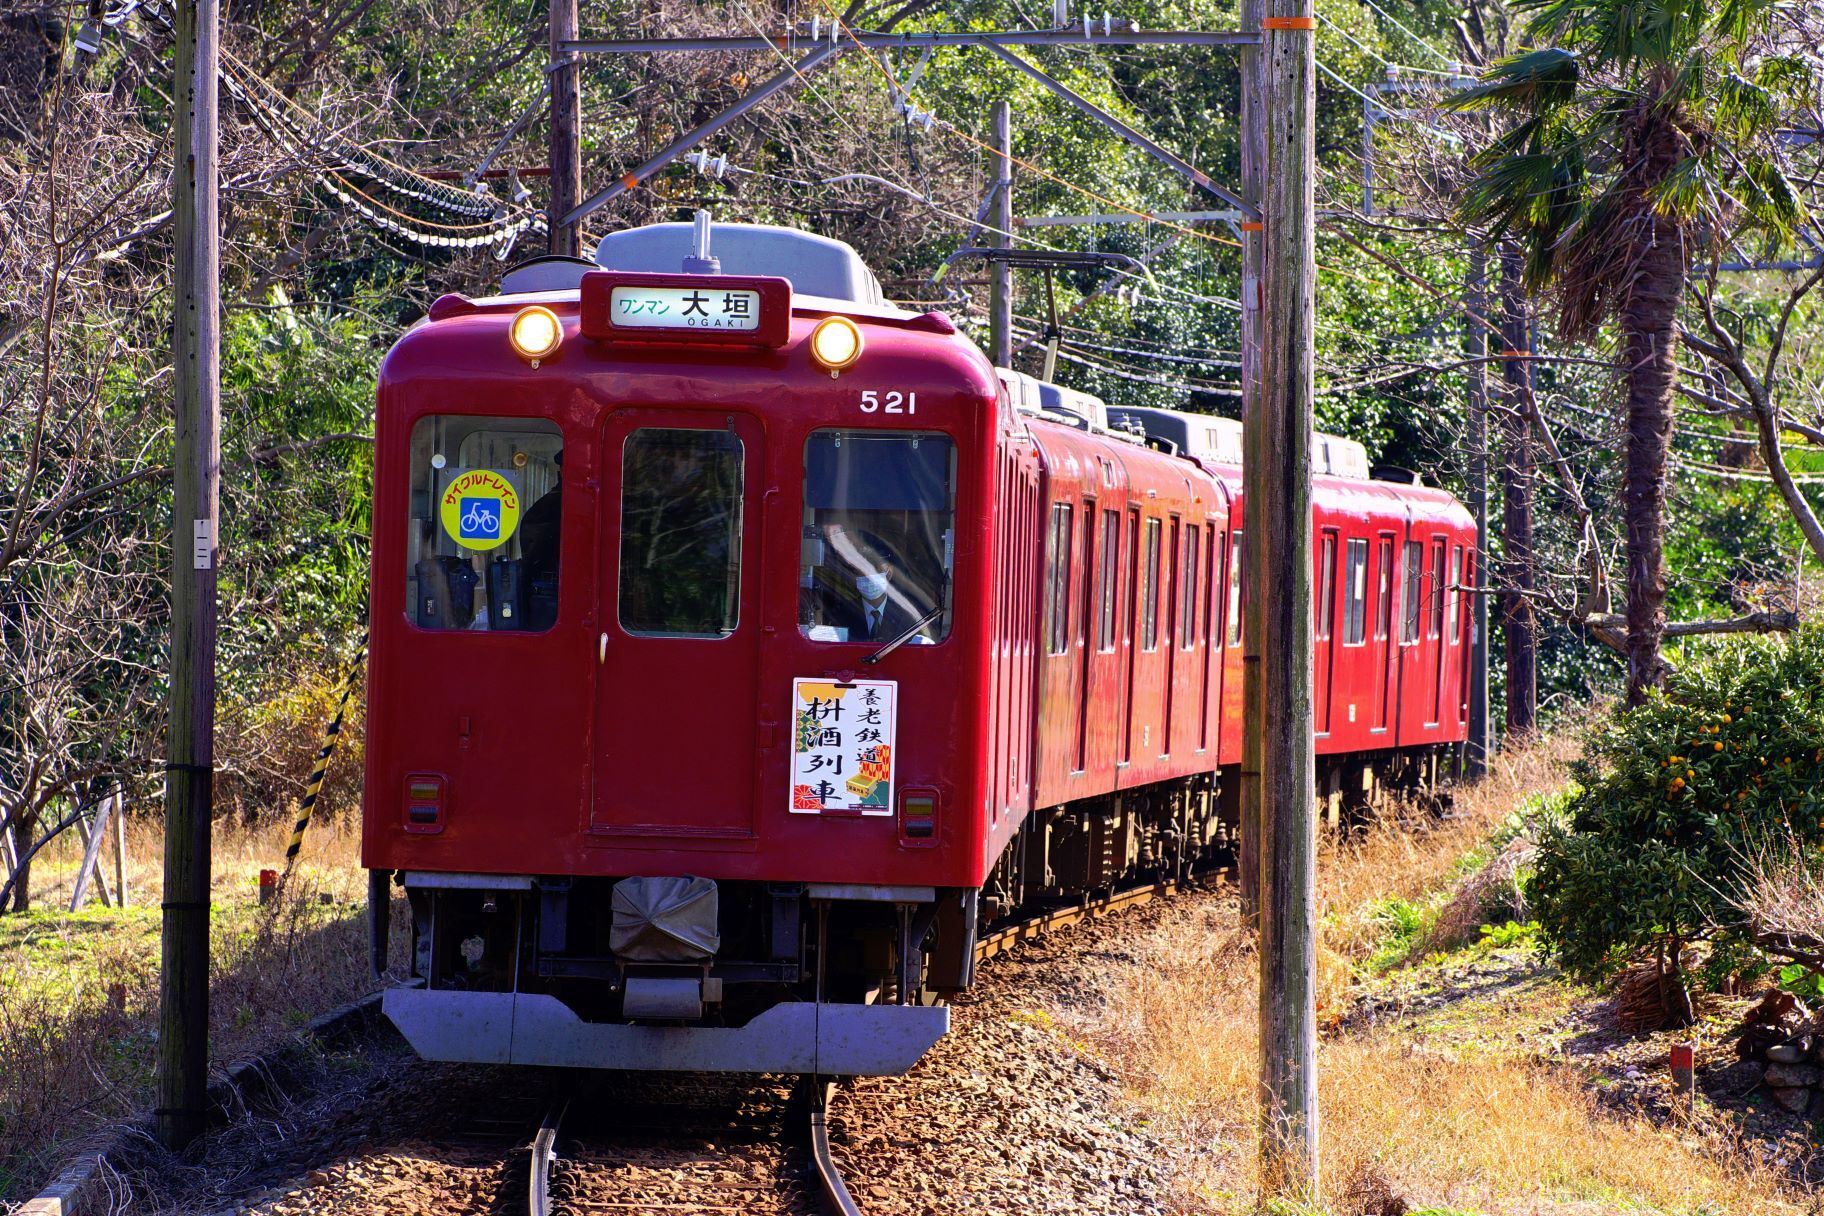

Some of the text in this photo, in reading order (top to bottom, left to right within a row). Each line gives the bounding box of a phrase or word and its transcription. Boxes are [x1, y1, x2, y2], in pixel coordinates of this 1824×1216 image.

[619, 290, 750, 318] ワンマン 大垣
[860, 391, 916, 415] 521
[446, 474, 515, 509] サイクルトレイン
[855, 688, 883, 765] 養老鉄道
